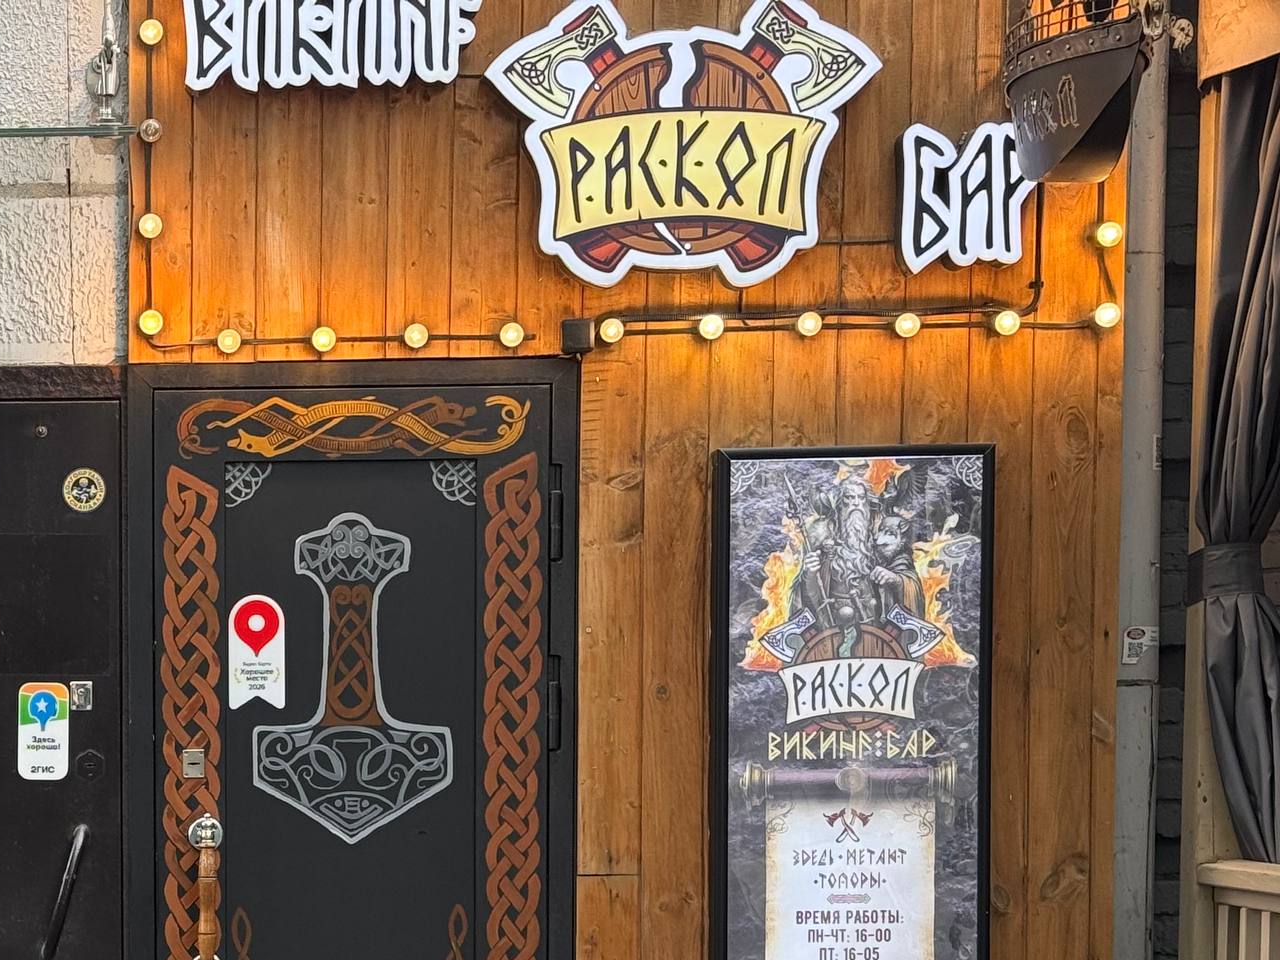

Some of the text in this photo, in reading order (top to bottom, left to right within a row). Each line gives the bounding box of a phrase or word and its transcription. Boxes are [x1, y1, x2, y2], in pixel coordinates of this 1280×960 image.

[240, 668, 274, 676] Хорошее
[32, 735, 56, 743] Здесь
[26, 743, 61, 752] хорошо!
[30, 765, 55, 774] 2ГИС
[796, 909, 904, 925] ВРЕМЯ РАБОТЫ:
[808, 928, 891, 943] ПН-ЧТ: 16-00
